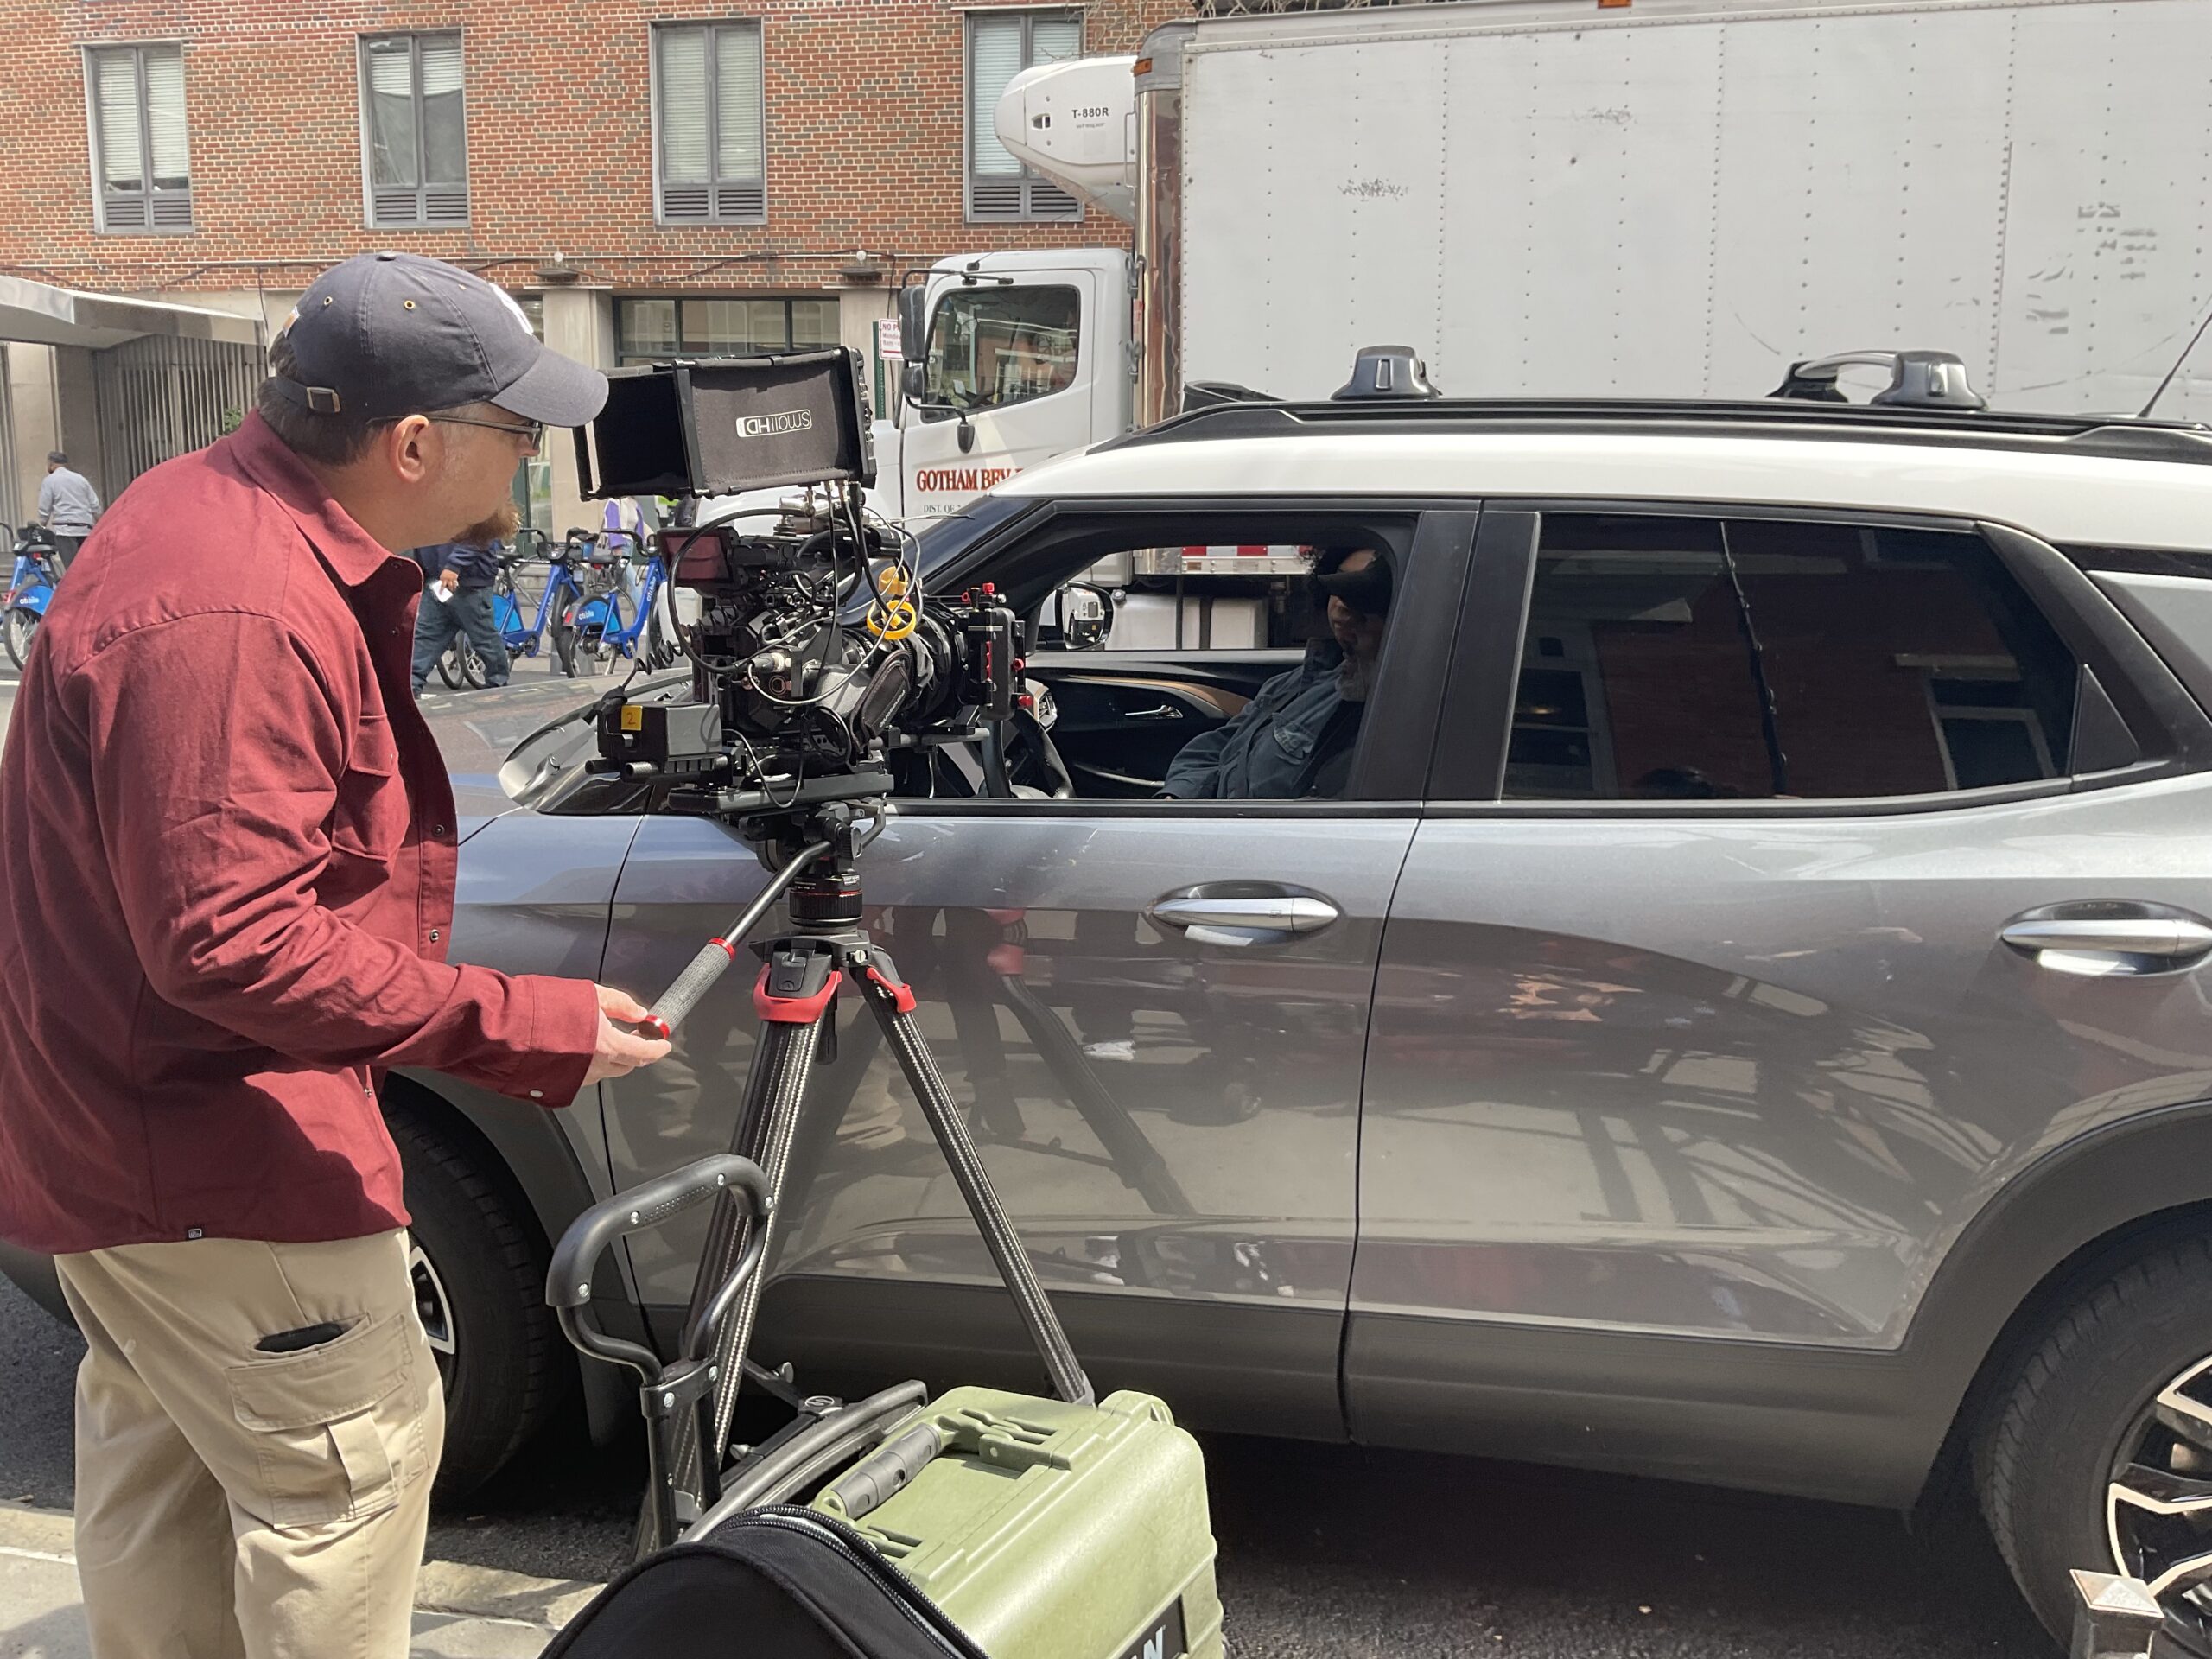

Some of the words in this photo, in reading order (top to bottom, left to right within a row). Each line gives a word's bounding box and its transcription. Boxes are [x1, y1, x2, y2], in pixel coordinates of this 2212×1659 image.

[1071, 107, 1109, 118] T-880R
[916, 469, 978, 492] GOTHAM
[923, 504, 942, 513] DIST.
[626, 712, 636, 725] 2
